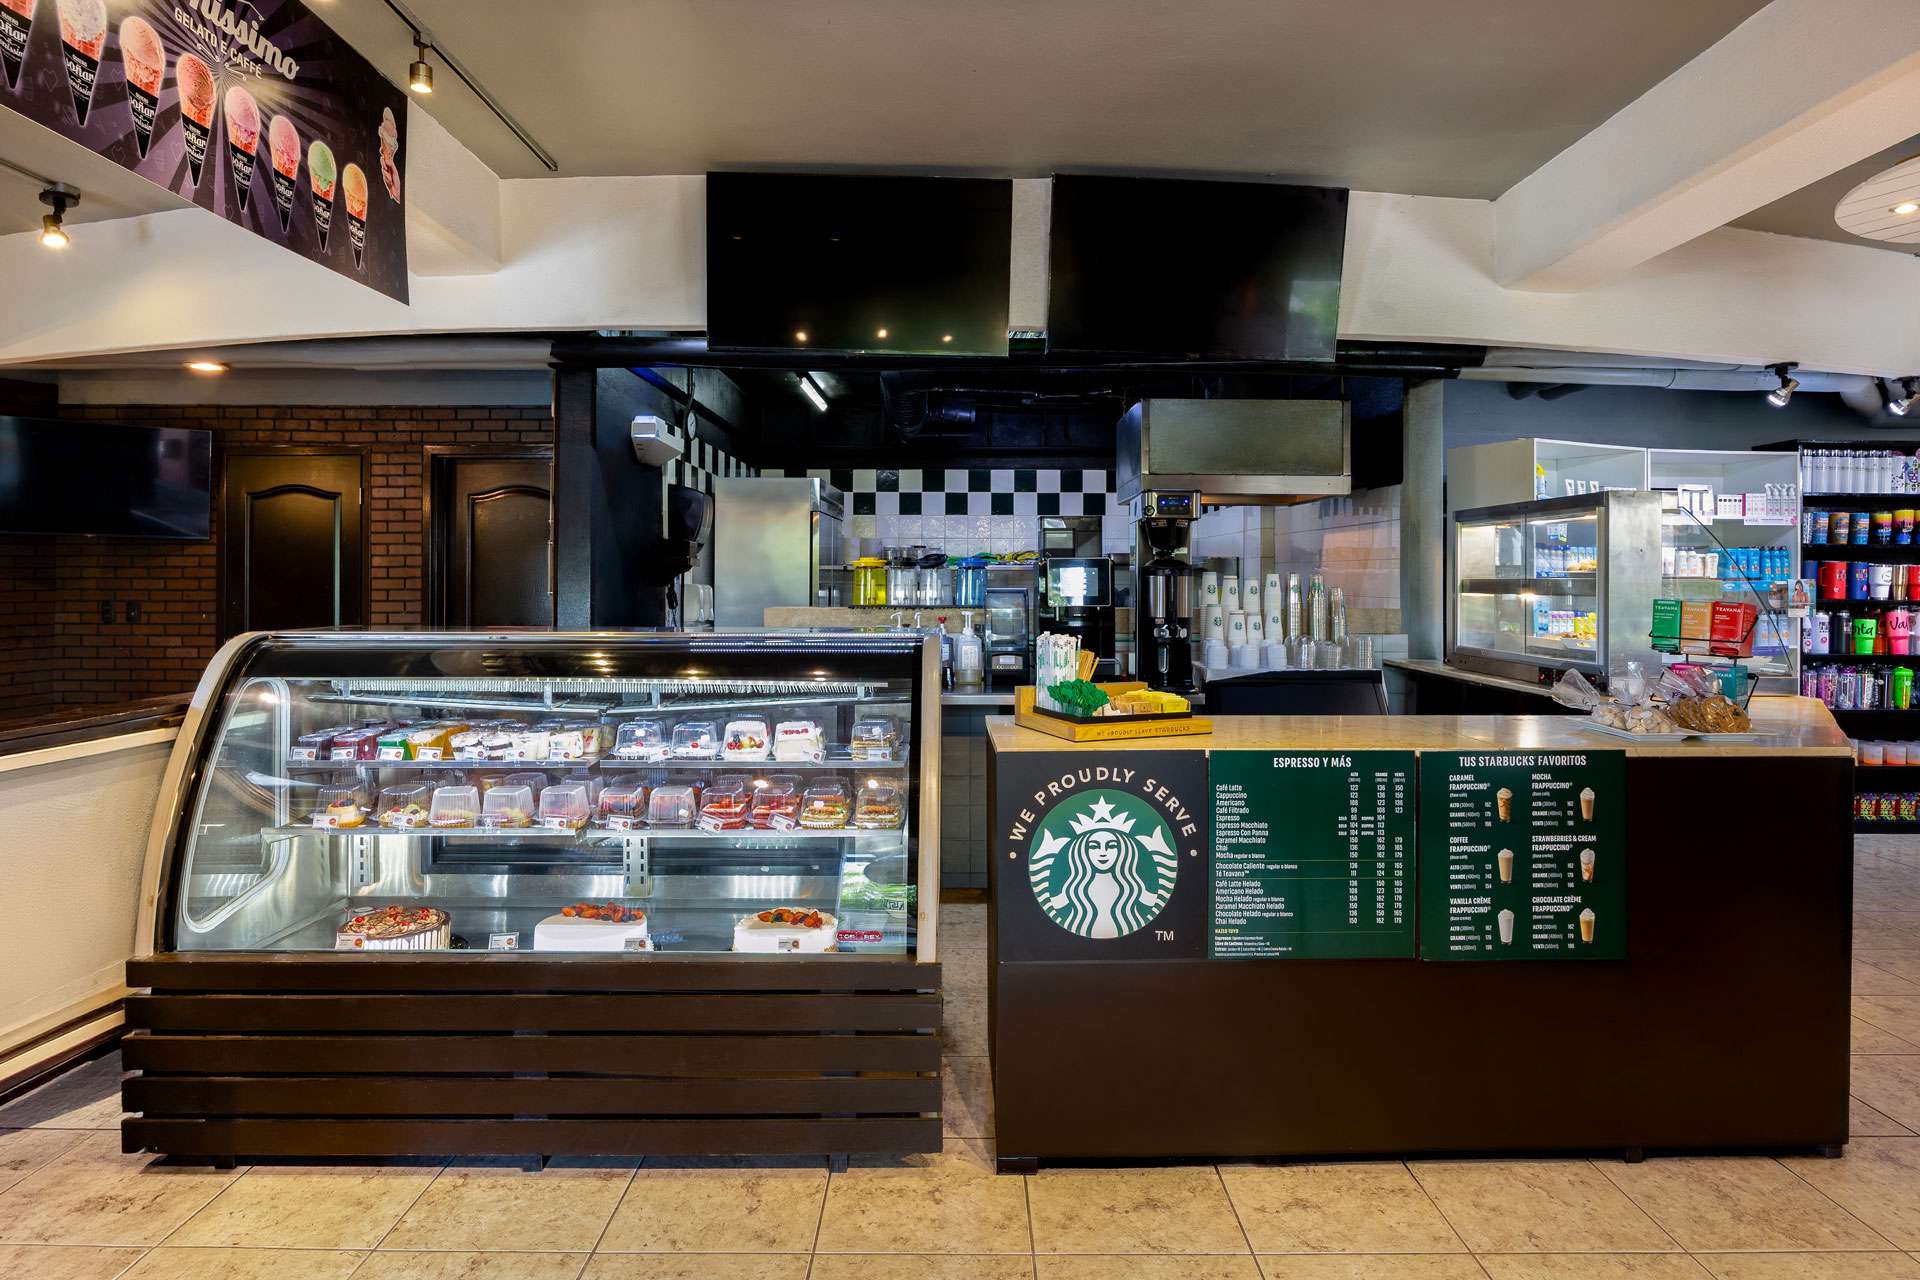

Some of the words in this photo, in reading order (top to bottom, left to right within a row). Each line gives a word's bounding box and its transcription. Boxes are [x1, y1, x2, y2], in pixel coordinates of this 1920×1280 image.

[174, 7, 218, 48] GELATO
[221, 39, 228, 55] E
[230, 47, 262, 79] CAFFÉ
[1273, 757, 1320, 768] ESPRESSO
[1322, 757, 1329, 768] Y
[1331, 755, 1352, 768] MÁS
[1459, 756, 1476, 767] TUS
[1537, 755, 1587, 766] FAVORITOS
[1449, 774, 1475, 782] CARAMEL
[1009, 809, 1036, 842] WE
[1034, 767, 1136, 807] PROUDLY
[1143, 778, 1197, 837] SERVE
[1449, 836, 1469, 844] COFFEE
[1473, 896, 1492, 904] CRÈME
[1563, 895, 1582, 903] CRÈME
[1155, 930, 1174, 941] TM
